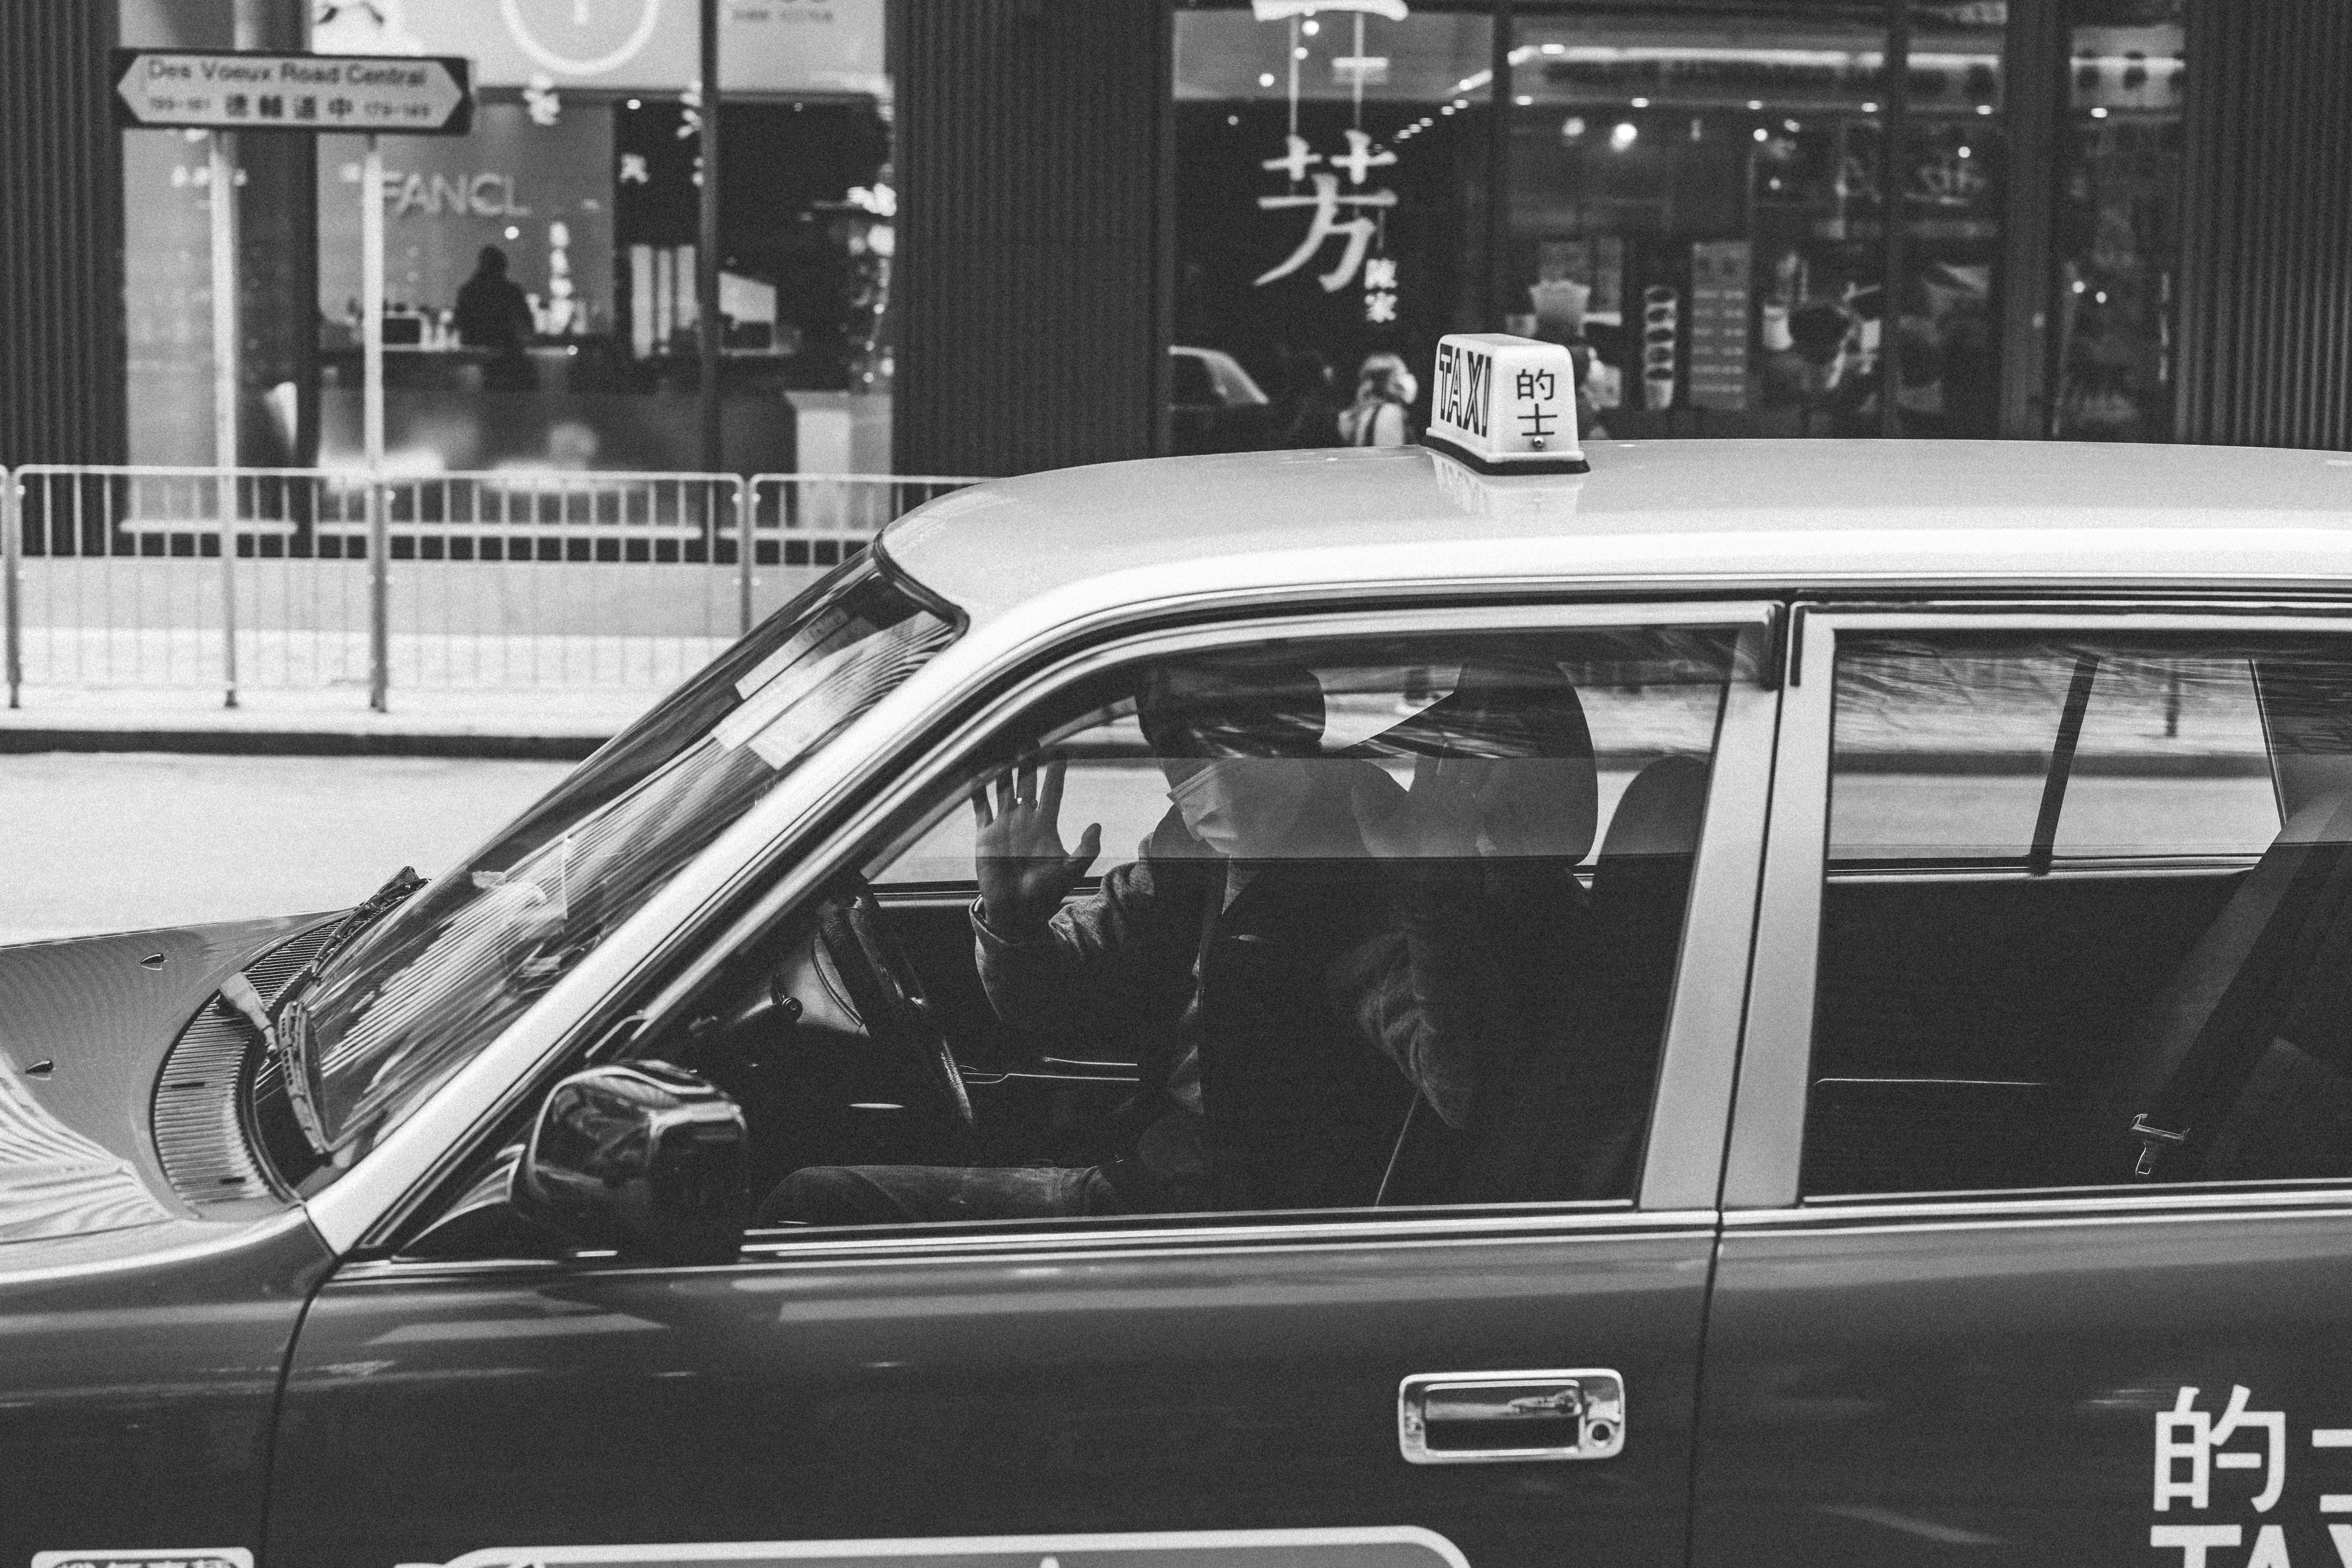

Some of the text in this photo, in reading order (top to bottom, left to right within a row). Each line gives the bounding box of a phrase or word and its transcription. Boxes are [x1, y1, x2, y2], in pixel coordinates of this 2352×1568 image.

[148, 60, 427, 86] Des Voeux Road Central
[383, 171, 532, 217] FANCL
[1439, 343, 1492, 438] TAXI
[1516, 368, 1558, 437] 的士
